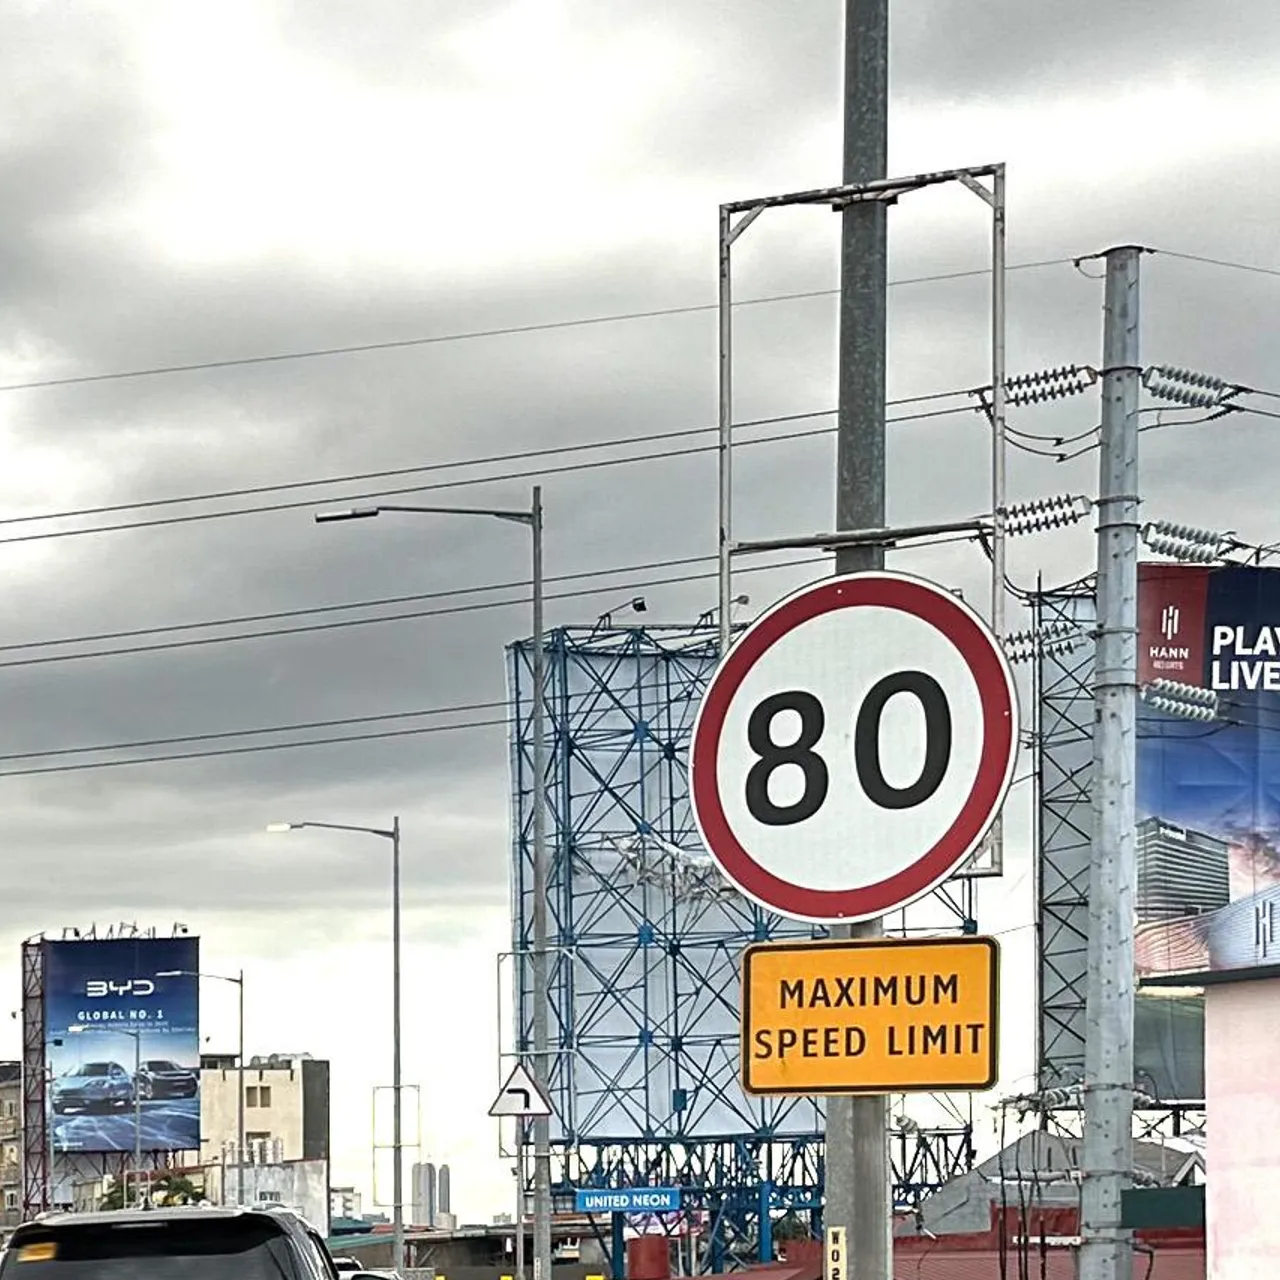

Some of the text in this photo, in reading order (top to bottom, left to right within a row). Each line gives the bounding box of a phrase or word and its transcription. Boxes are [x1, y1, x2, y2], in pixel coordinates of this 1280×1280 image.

[1149, 646, 1190, 660] HANN
[744, 669, 953, 827] 80
[86, 979, 155, 998] BYD
[779, 973, 959, 1010] MAXIMUM
[76, 1009, 125, 1021] GLOBAL
[129, 1009, 152, 1020] NO.
[754, 1023, 985, 1060] SPEED LIMIT
[585, 1194, 671, 1208] UNITED NEON
